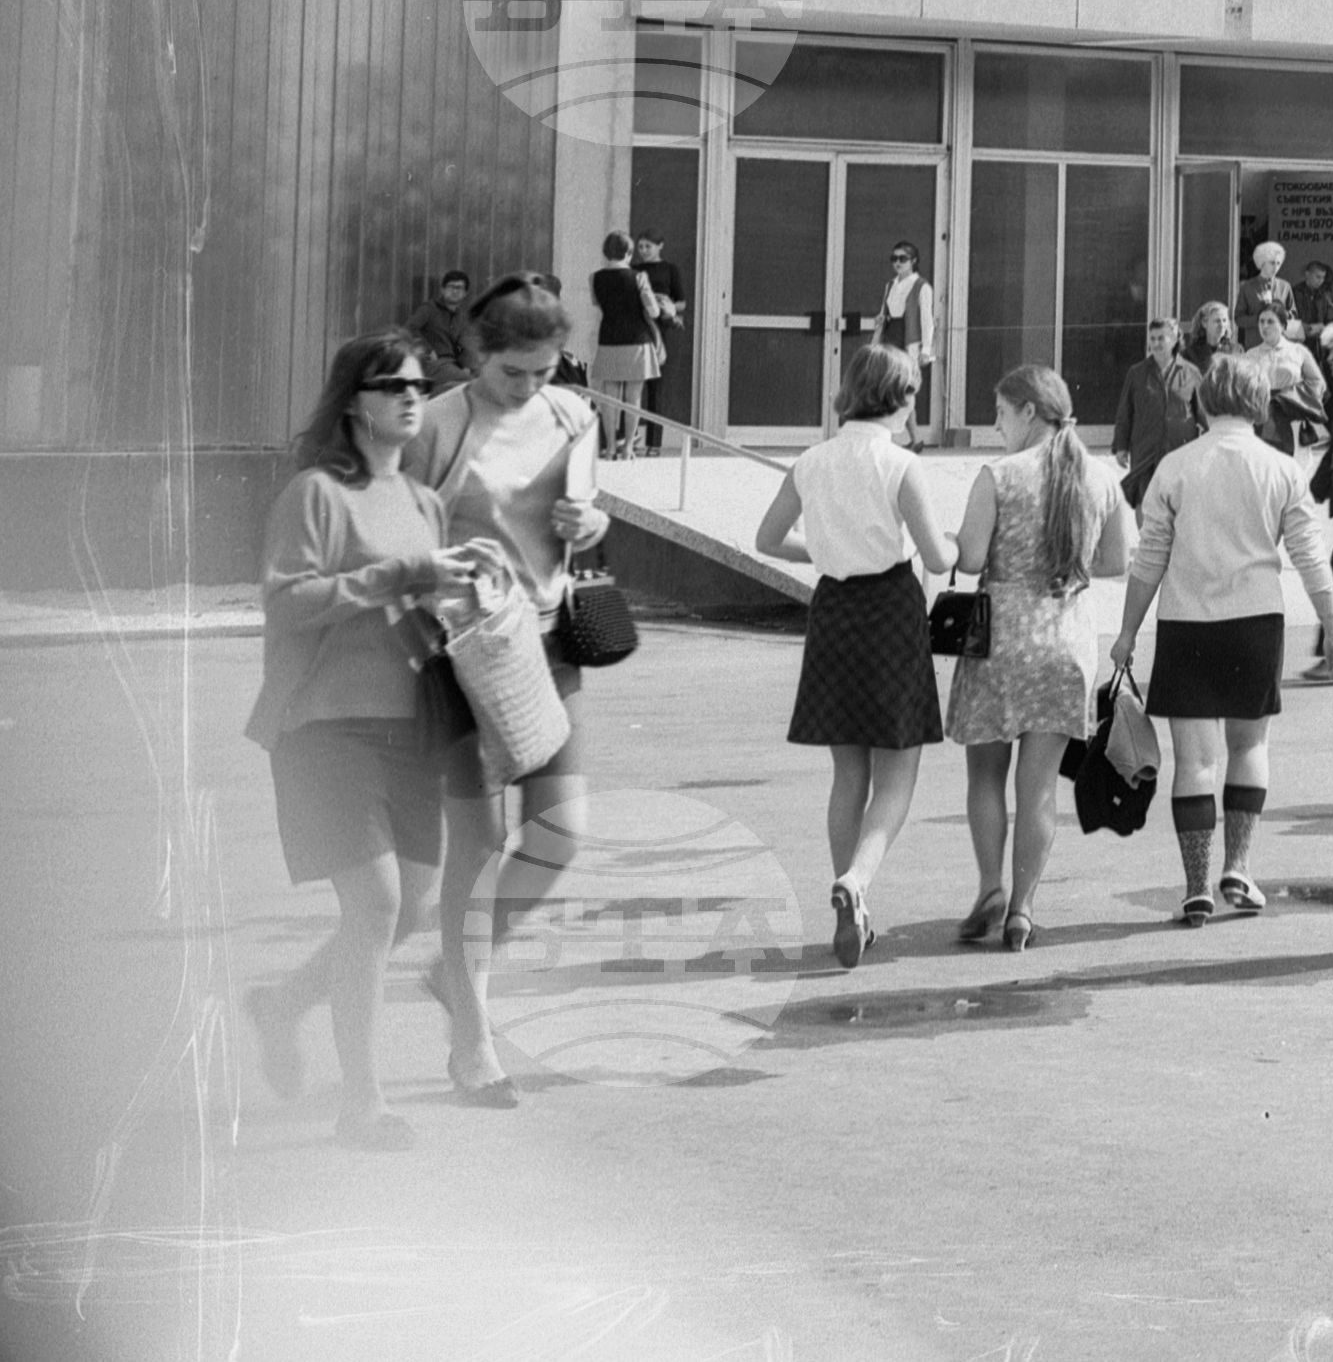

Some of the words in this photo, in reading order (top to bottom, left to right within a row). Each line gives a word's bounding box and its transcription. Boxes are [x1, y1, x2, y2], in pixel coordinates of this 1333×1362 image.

[1276, 195, 1332, 204] СЪВЕТСКИЯ
[1281, 207, 1288, 216] С
[1291, 207, 1311, 216] НРБ
[1282, 220, 1306, 229] ПРЕЗ
[1309, 218, 1333, 229] 1970
